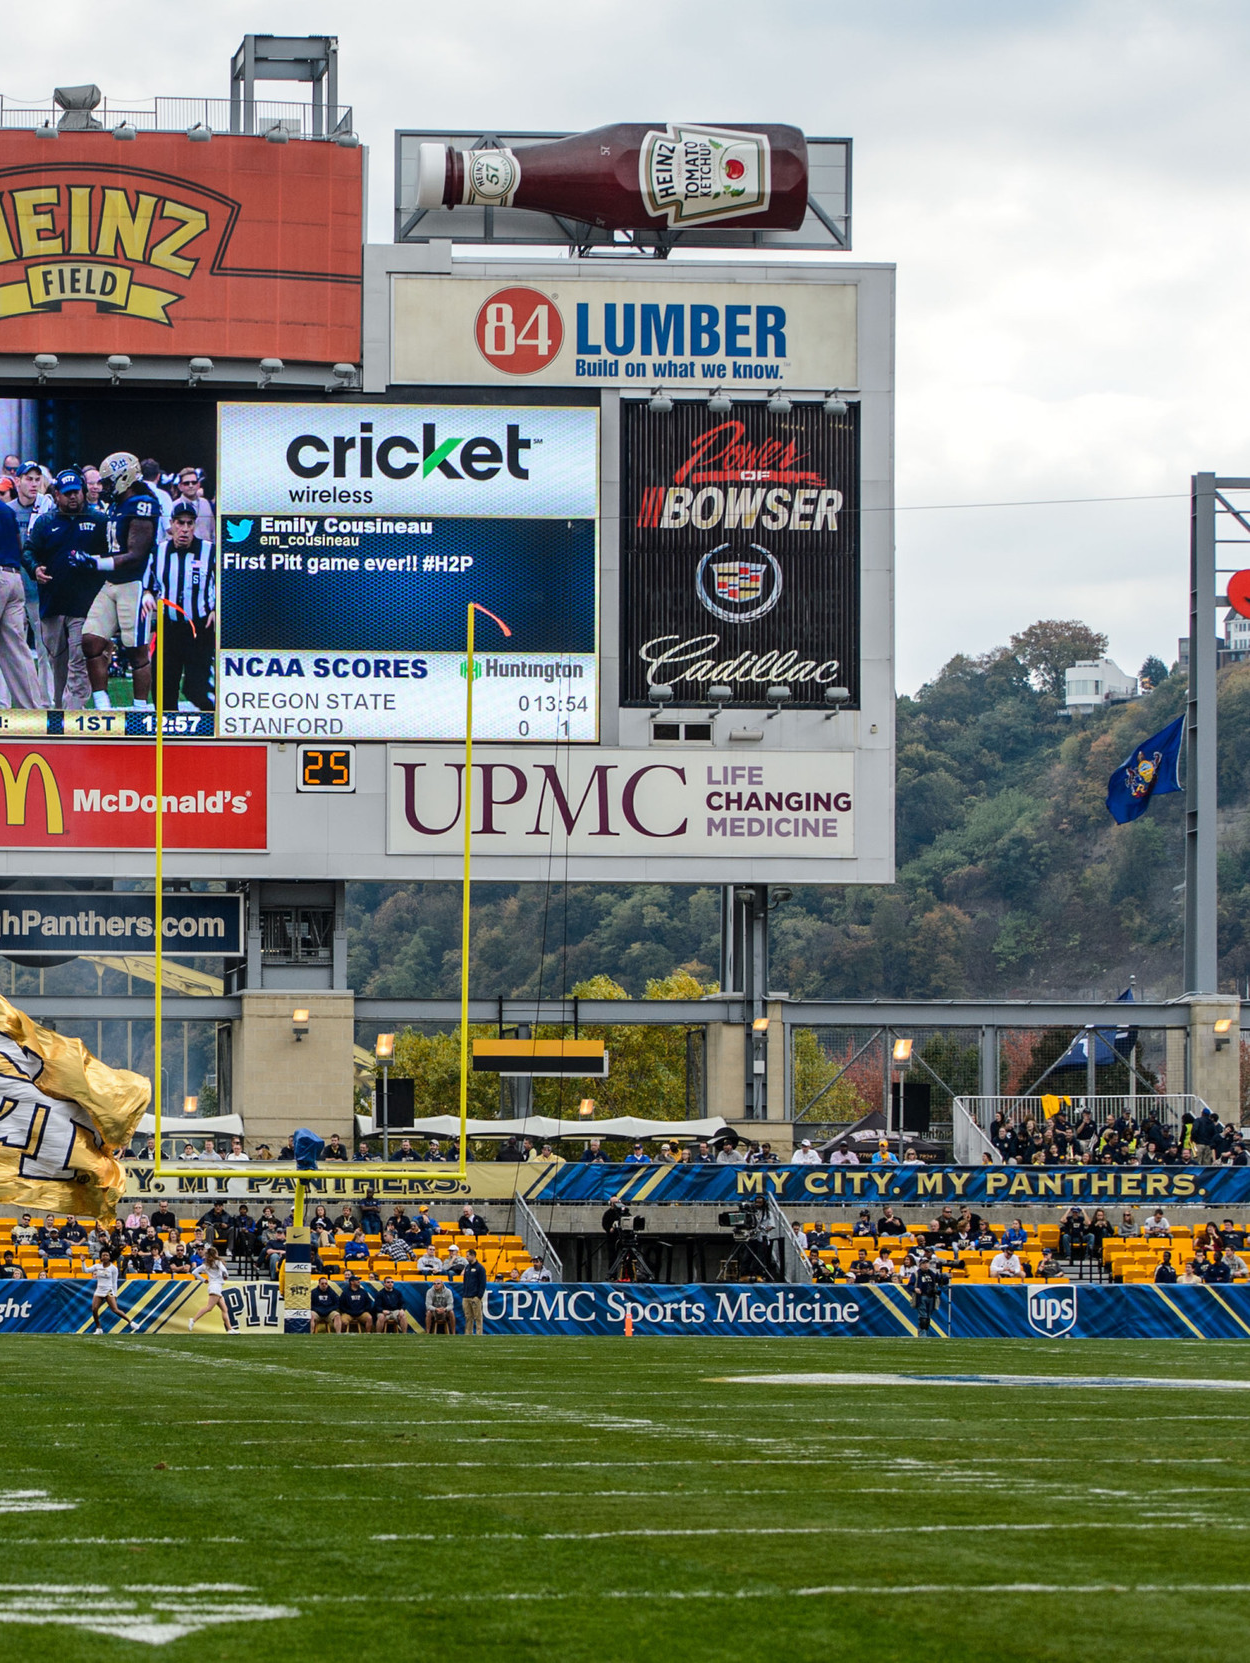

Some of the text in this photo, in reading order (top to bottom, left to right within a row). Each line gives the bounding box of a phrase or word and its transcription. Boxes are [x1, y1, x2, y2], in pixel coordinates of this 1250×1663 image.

[475, 161, 485, 187] HEINZ
[486, 163, 499, 186] 57
[656, 143, 677, 200] HEINZ
[684, 141, 700, 200] TOMATO
[699, 143, 712, 197] KETCHUP
[42, 268, 117, 297] FIELD
[484, 303, 552, 356] 84
[576, 303, 787, 358] LUMBER
[575, 359, 784, 380] Build on what we know.
[286, 422, 532, 481] cricket
[673, 420, 810, 485] Power
[110, 459, 127, 472] Pitt
[740, 470, 770, 481] OF
[289, 486, 373, 505] wireless
[136, 501, 152, 516] 91
[660, 486, 843, 531] BOWSER
[260, 517, 433, 537] Emily Cousineau
[259, 534, 360, 549] em_cousineau
[223, 553, 474, 574] First Pitt game ever!! #H2P
[193, 575, 199, 584] S
[224, 657, 428, 679] NCAA SCORES
[486, 658, 583, 683] Huntington
[638, 634, 840, 687] Cadillac
[224, 692, 588, 712] OREGON STATE 0 13:54
[74, 716, 116, 731] 1ST
[142, 716, 201, 732] 12:57
[224, 717, 568, 736] STANFORD 0 1
[304, 751, 348, 785] 25
[706, 766, 764, 786] LIFE
[73, 789, 248, 814] McDonald's
[393, 762, 689, 838] UPMC
[706, 791, 852, 812] CHANGING
[706, 817, 838, 837] MEDICINE
[736, 1171, 1207, 1197] MY CITY. MY PANTHERS.
[290, 1286, 309, 1296] PITT
[221, 1283, 283, 1329] PIT
[483, 1290, 860, 1323] UPMC Sports Medicine
[1031, 1298, 1073, 1329] ups
